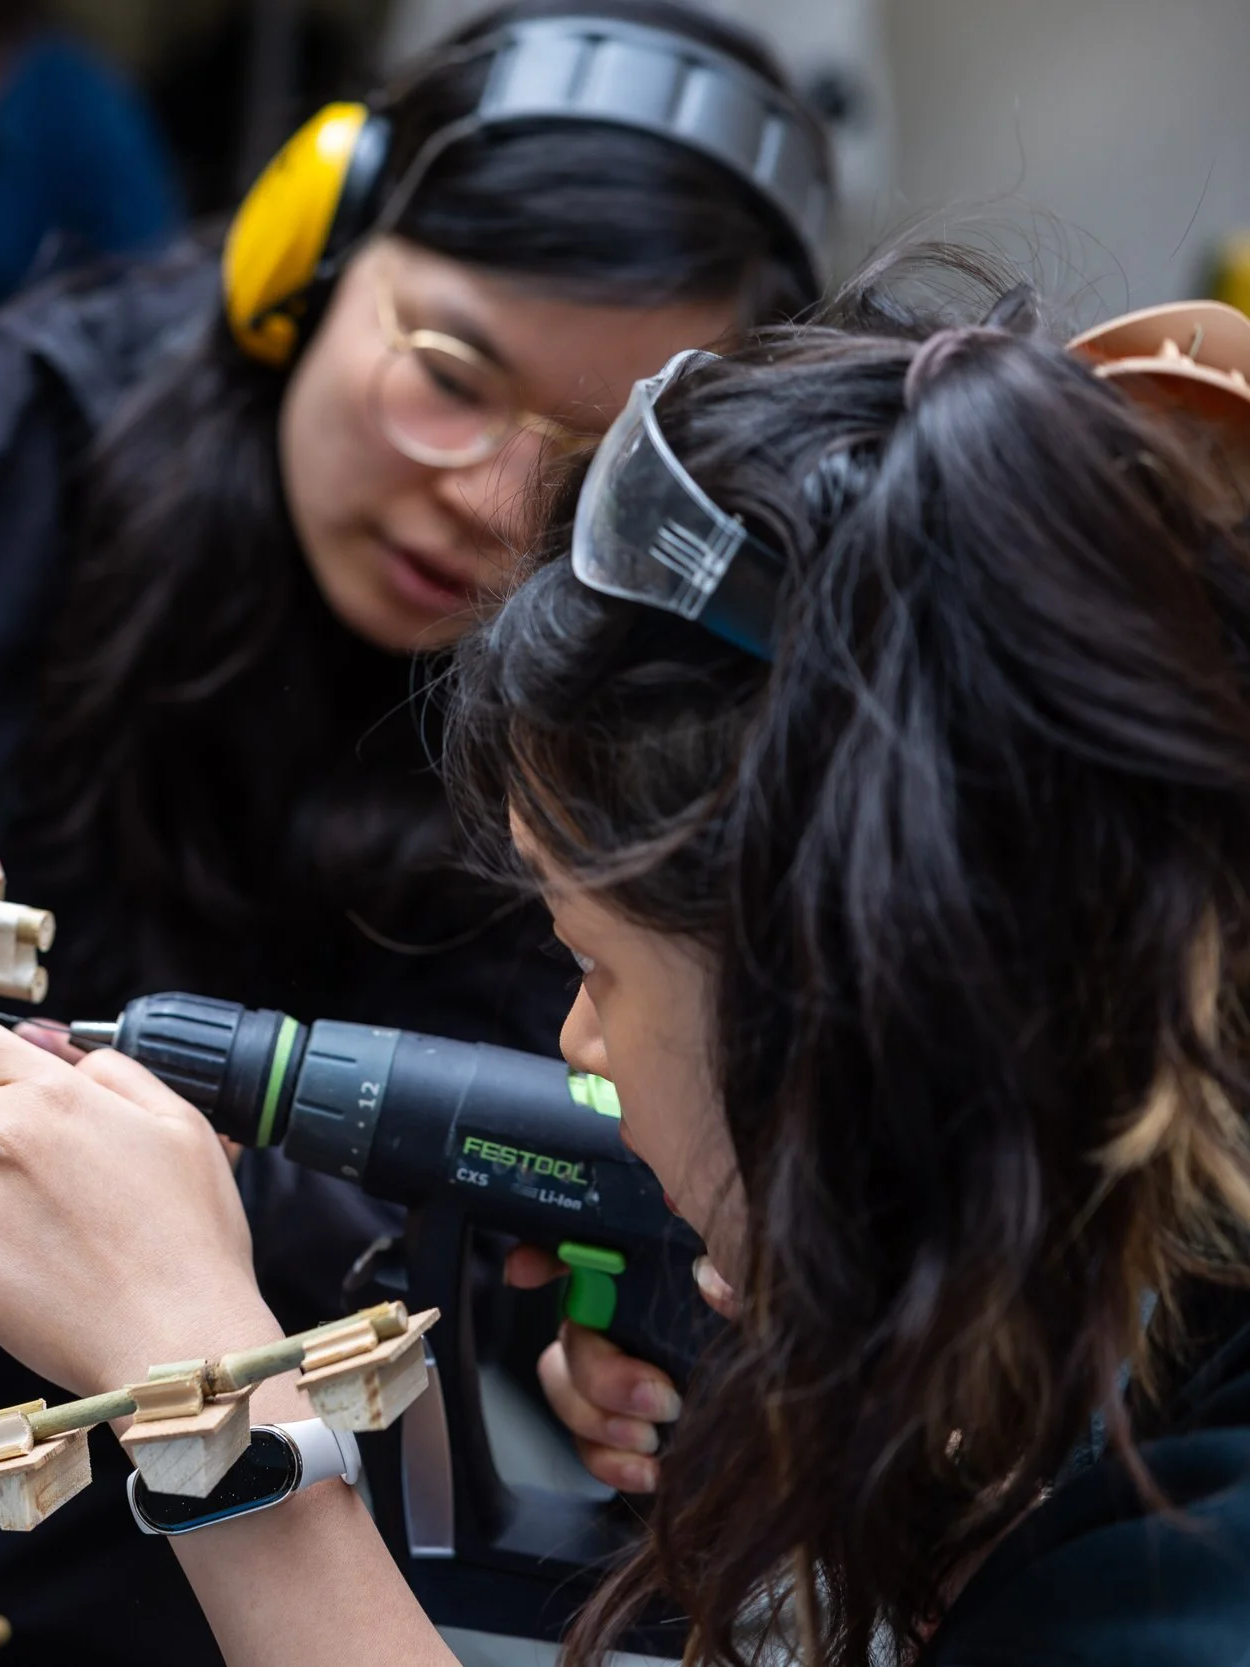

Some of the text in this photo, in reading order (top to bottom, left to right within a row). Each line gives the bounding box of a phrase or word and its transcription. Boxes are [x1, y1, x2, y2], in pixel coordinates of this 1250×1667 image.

[358, 1081, 380, 1109] 12
[462, 1136, 588, 1186] FESTOOL
[539, 1188, 583, 1211] Li-Ion
